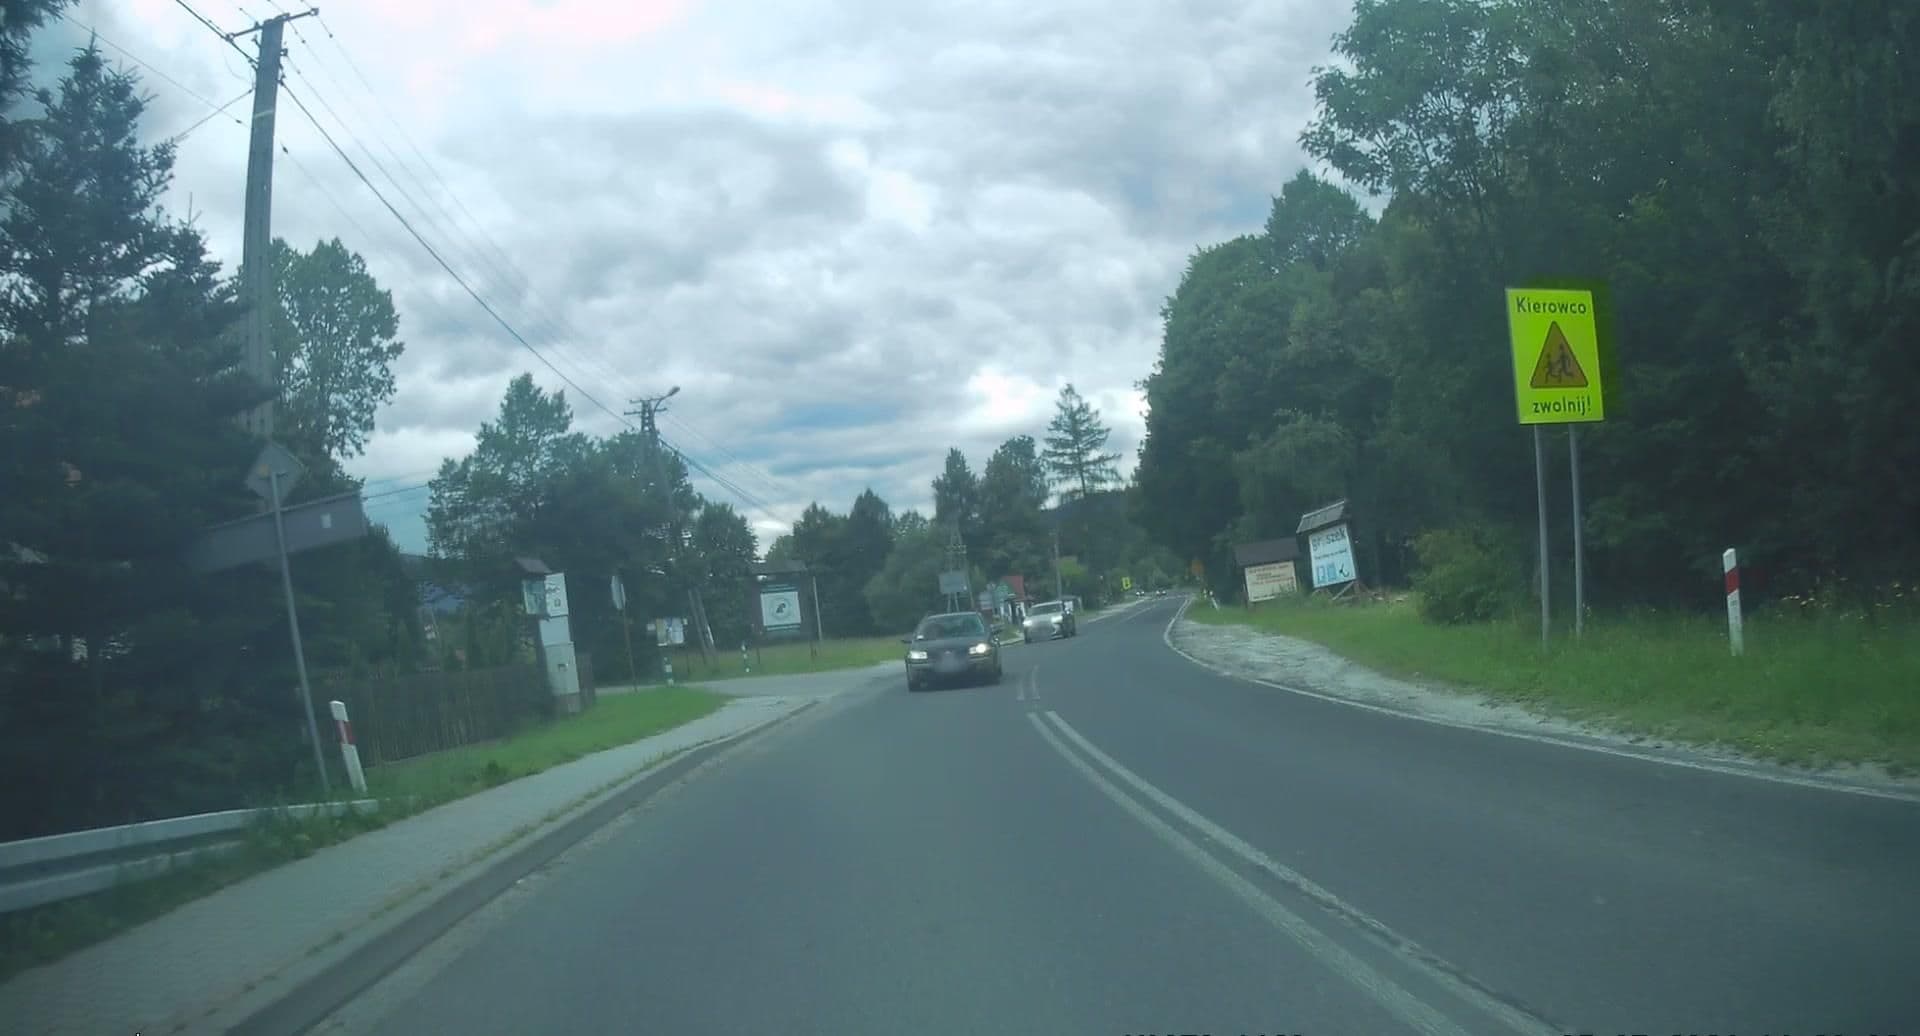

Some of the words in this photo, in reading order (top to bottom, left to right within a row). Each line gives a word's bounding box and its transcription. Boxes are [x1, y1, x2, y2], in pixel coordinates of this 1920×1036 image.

[1516, 297, 1586, 314] Kierowco
[1533, 395, 1591, 415] zwolnij!
[1312, 527, 1346, 551] grszek
